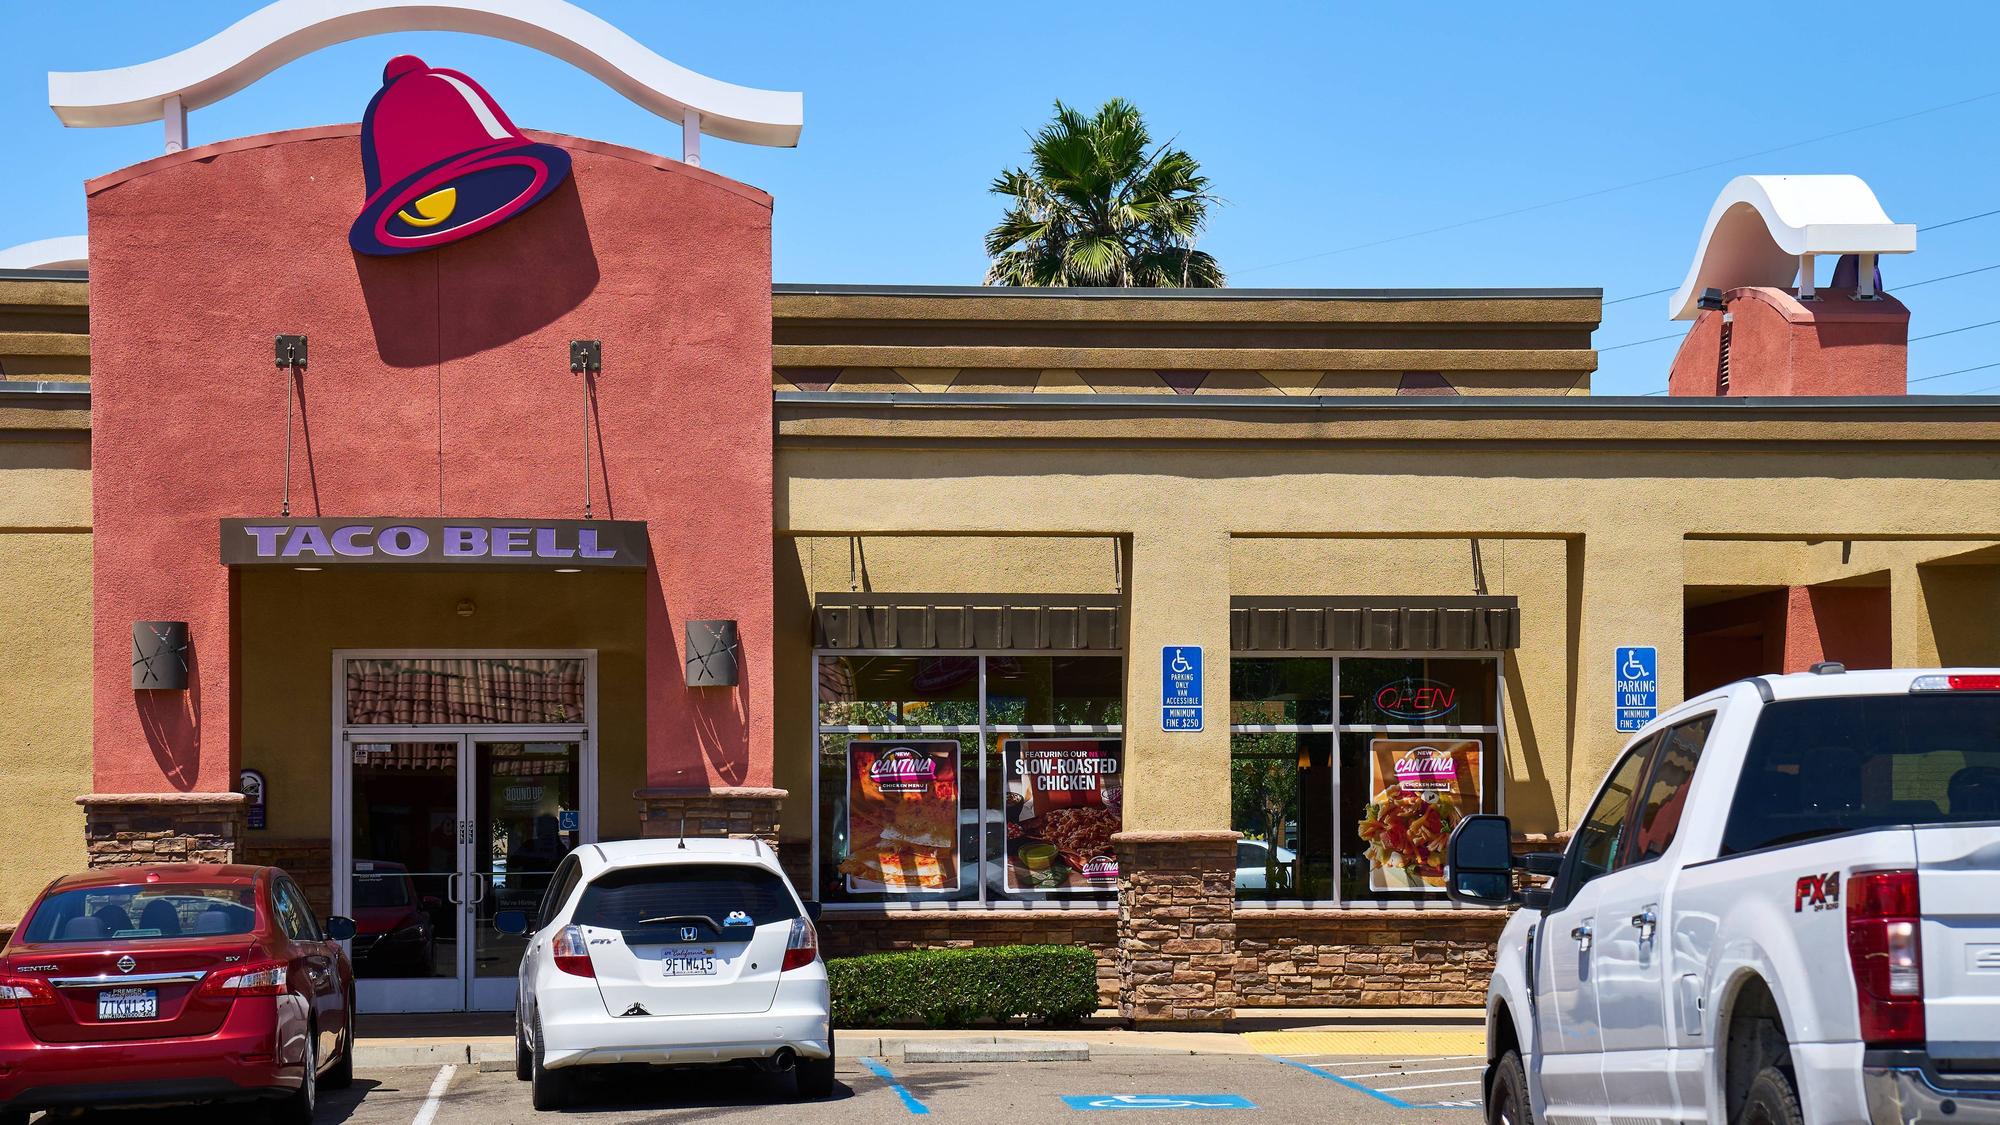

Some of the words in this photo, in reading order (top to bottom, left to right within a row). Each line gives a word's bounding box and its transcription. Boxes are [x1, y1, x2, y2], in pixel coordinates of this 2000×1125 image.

[244, 525, 429, 558] TACO
[443, 527, 616, 560] BELL
[1171, 673, 1194, 681] PARKING
[1175, 681, 1189, 689] ONLY
[1617, 680, 1655, 693] PARKING
[1177, 689, 1188, 697] VAN
[1378, 687, 1456, 709] OPEN
[1625, 693, 1648, 706] ONLY
[1166, 697, 1199, 705] ACCESSIBLE
[1169, 708, 1196, 718] MINIMUM
[1623, 710, 1650, 719] MINIMUM
[1166, 718, 1179, 728] FINE
[1182, 718, 1199, 728] $250
[1619, 719, 1634, 728] FINE
[870, 757, 932, 774] CANTINA
[1015, 758, 1117, 775] SLOW-ROASTED
[1394, 757, 1454, 773] CANTINA
[1037, 774, 1096, 791] CHICKEN
[1082, 861, 1119, 873] CANTINA
[1795, 871, 1841, 913] FX4
[17, 964, 60, 972] SENTRA
[665, 957, 713, 972] 9FTM415
[101, 998, 154, 1015] 7TKW133
